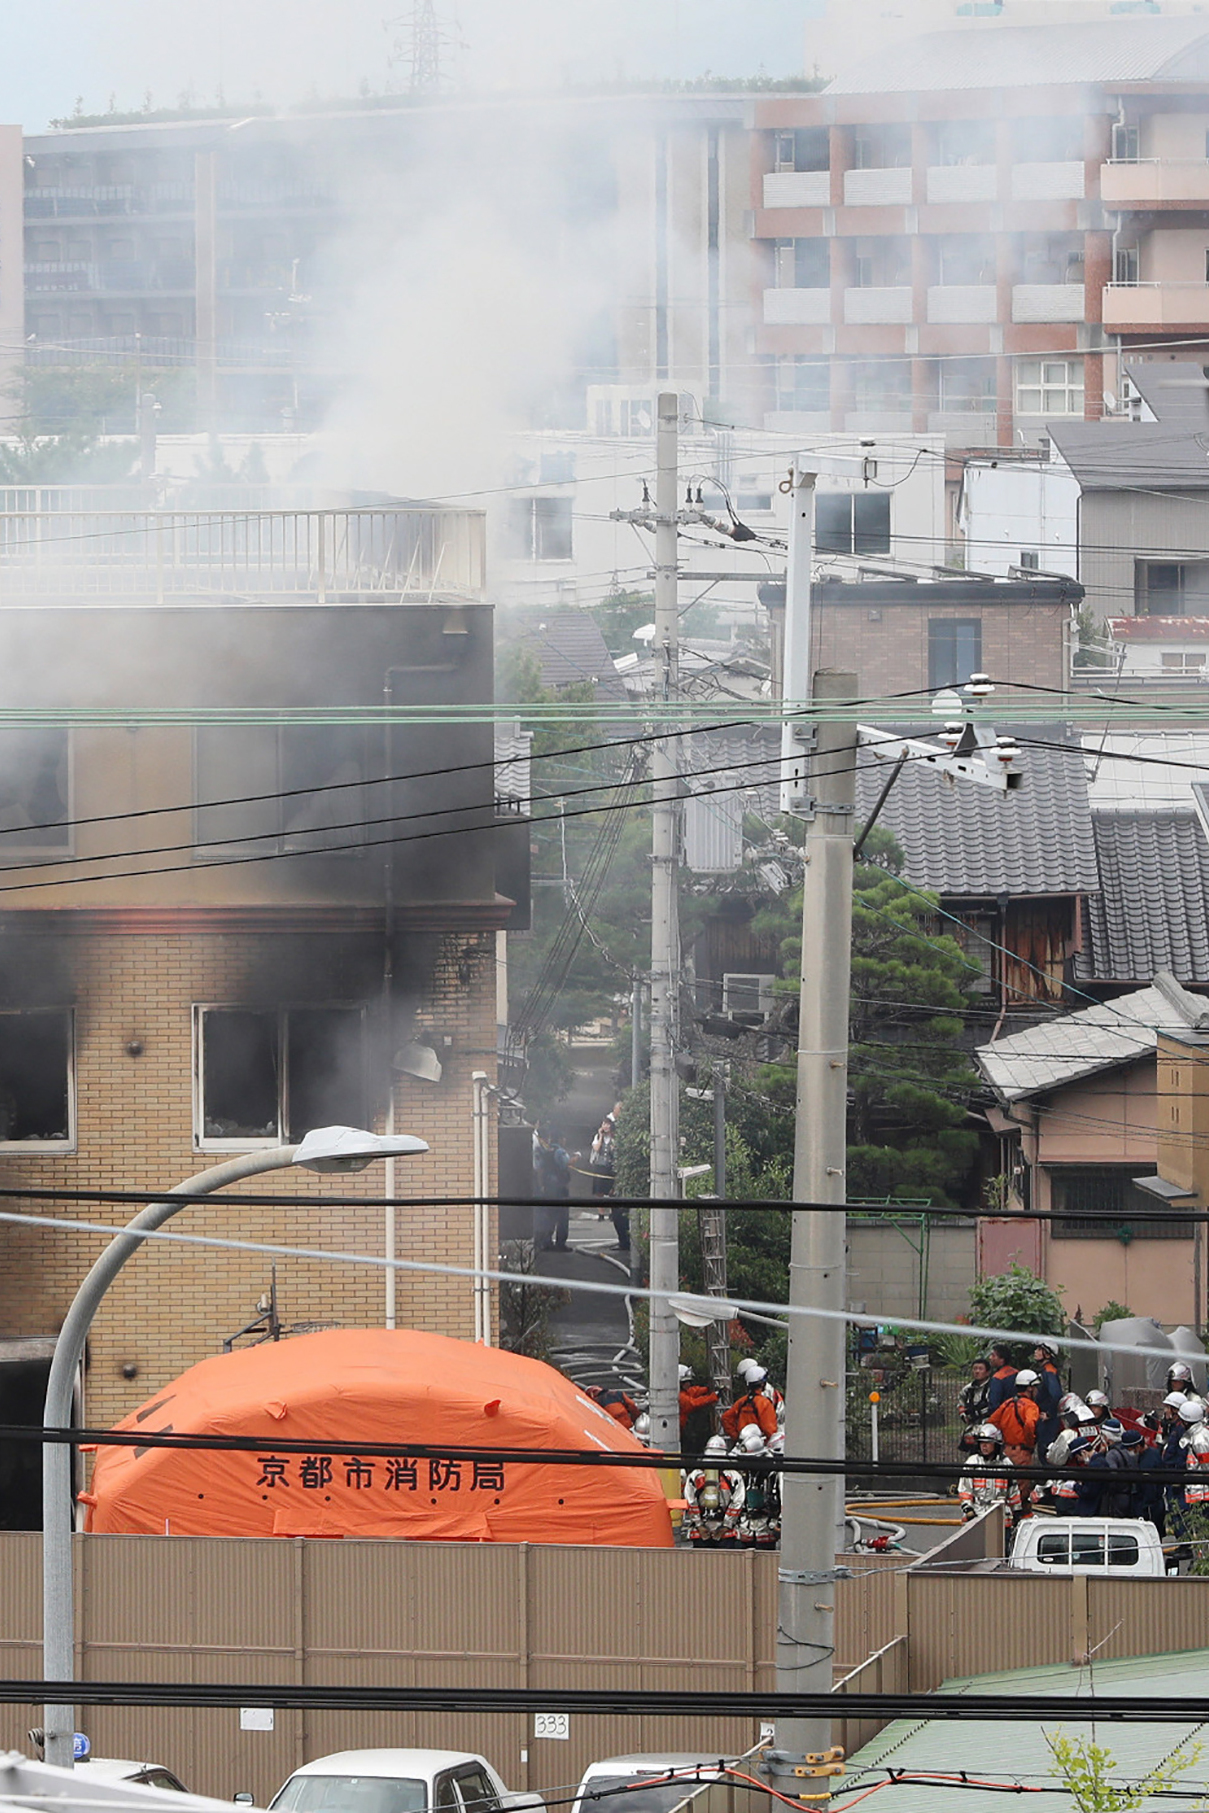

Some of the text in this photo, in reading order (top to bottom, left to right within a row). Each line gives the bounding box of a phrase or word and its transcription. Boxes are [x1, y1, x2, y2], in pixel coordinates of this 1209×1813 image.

[256, 1455, 505, 1492] 京都市消防局
[536, 1715, 567, 1734] 333
